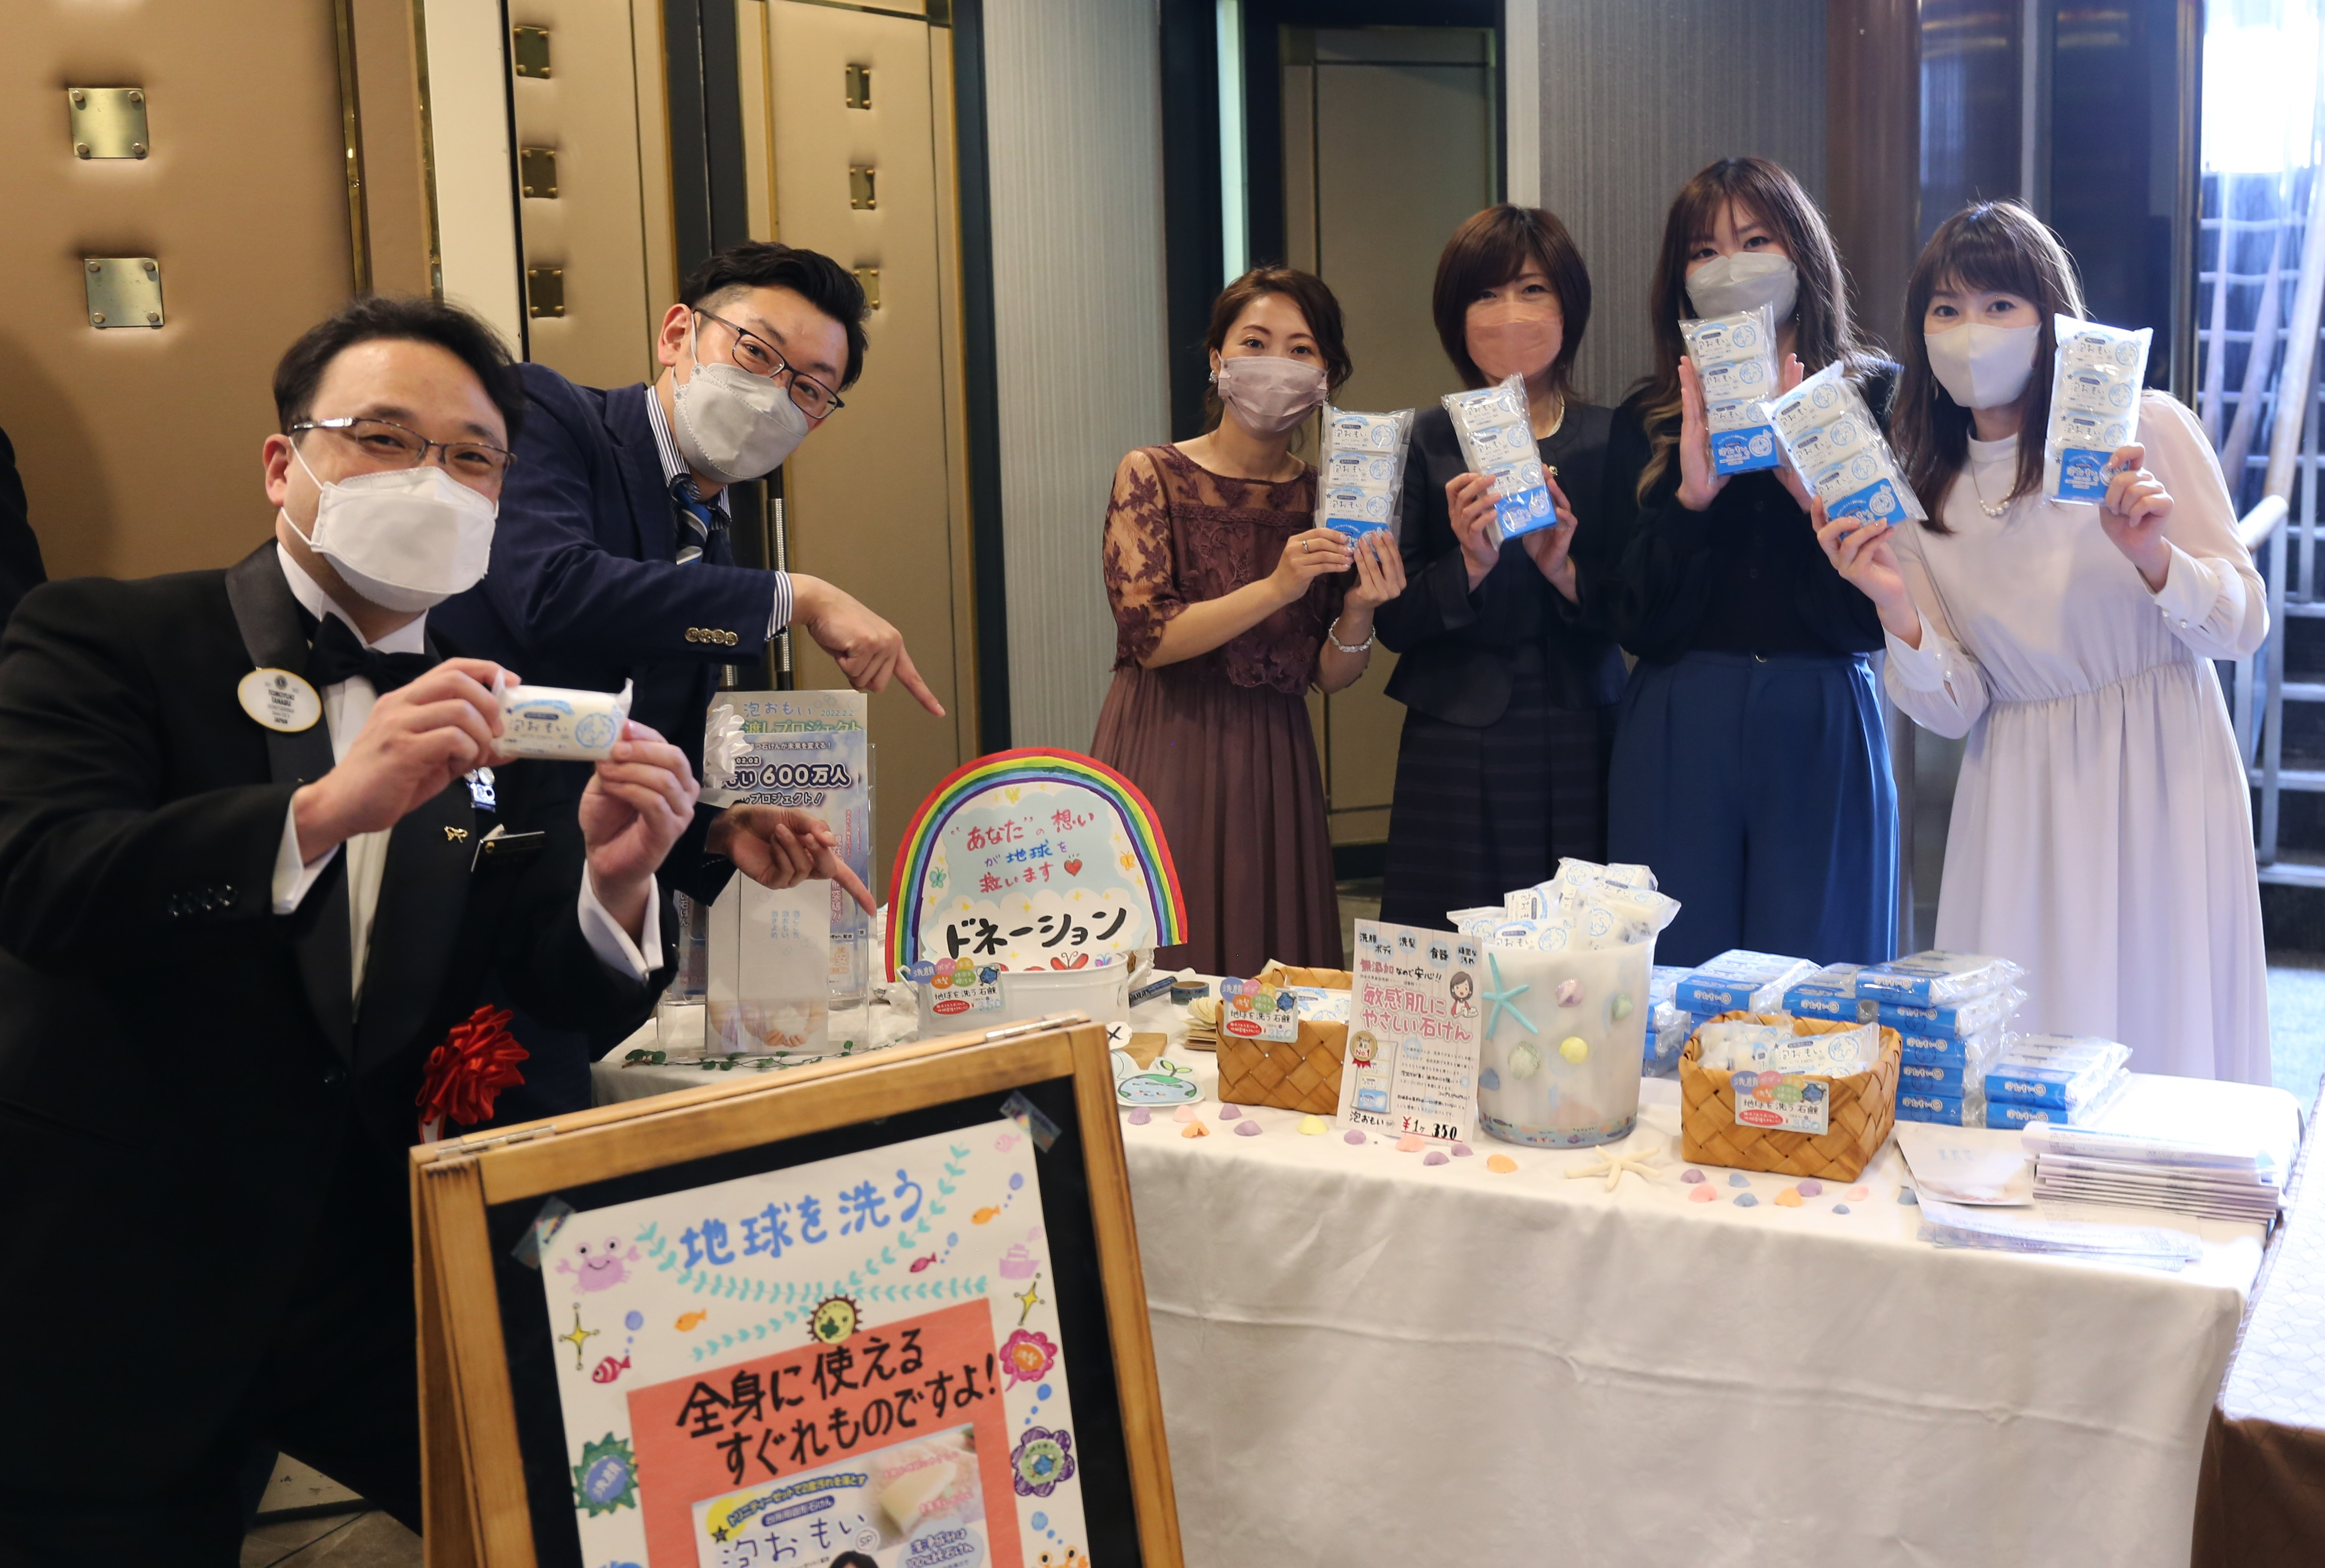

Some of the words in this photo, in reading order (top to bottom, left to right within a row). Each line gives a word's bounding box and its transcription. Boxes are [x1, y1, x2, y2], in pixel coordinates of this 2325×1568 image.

[1334, 429, 1367, 438] 泡おもい
[1333, 464, 1365, 473] 泡おもい
[743, 701, 812, 718] 泡おもい
[761, 764, 851, 788] 600万人
[984, 839, 1067, 867] が地球を
[979, 861, 1053, 893] 救います
[947, 907, 1126, 959] ドネーション
[1359, 933, 1376, 943] 洗顔
[1375, 944, 1391, 955] ボディ
[1399, 937, 1416, 949] 洗髪
[1431, 947, 1449, 961] 食器
[1461, 956, 1475, 965] 汚れ
[1362, 982, 1447, 1016] 敏感肌に
[1361, 1008, 1472, 1041] やさしい石けん
[1355, 1049, 1371, 1058] No.1
[1779, 1048, 1822, 1060] 泡おもい
[1349, 1111, 1384, 1125] 泡おもい
[1432, 1123, 1457, 1140] 350
[680, 1168, 922, 1269] 地球を洗う
[677, 1328, 923, 1438] 全身に使える
[716, 1354, 996, 1485] すぐれものですよ!
